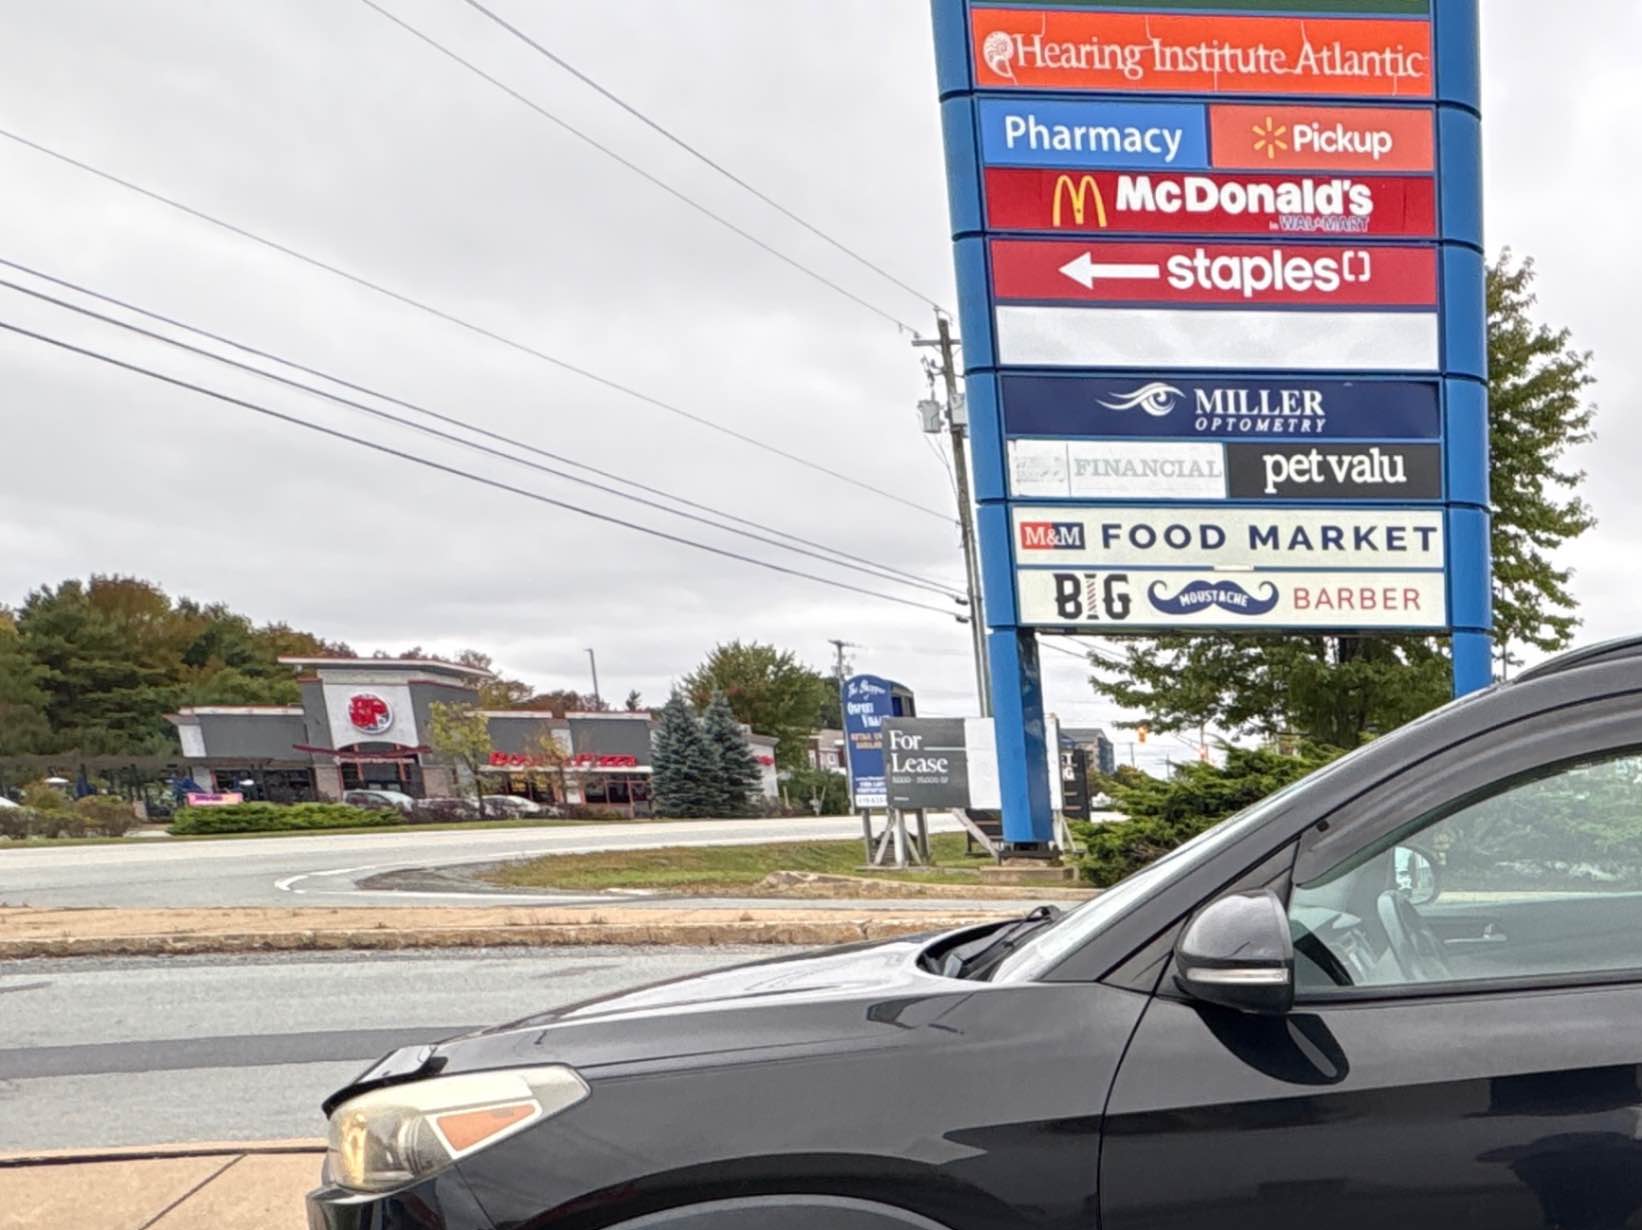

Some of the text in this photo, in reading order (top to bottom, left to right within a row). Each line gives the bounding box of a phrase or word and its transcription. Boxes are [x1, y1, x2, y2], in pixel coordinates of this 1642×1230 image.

[1012, 33, 1424, 80] Hearing Institute Atlantic
[1004, 115, 1183, 162] Pharmacy
[1293, 123, 1392, 159] Pickup
[1116, 175, 1374, 215] McDonald's
[1167, 249, 1340, 298] staples
[1194, 388, 1326, 416] MILLER
[1195, 416, 1327, 433] OPTOMETRY
[1073, 458, 1223, 478] FINANCIAL
[1262, 447, 1407, 494] pet valu
[1023, 523, 1438, 551] M&M FOOD MARKET
[1052, 573, 1422, 620] BIG MOUSTACHE BARBER
[888, 730, 922, 750] For
[891, 752, 948, 773] Lease
